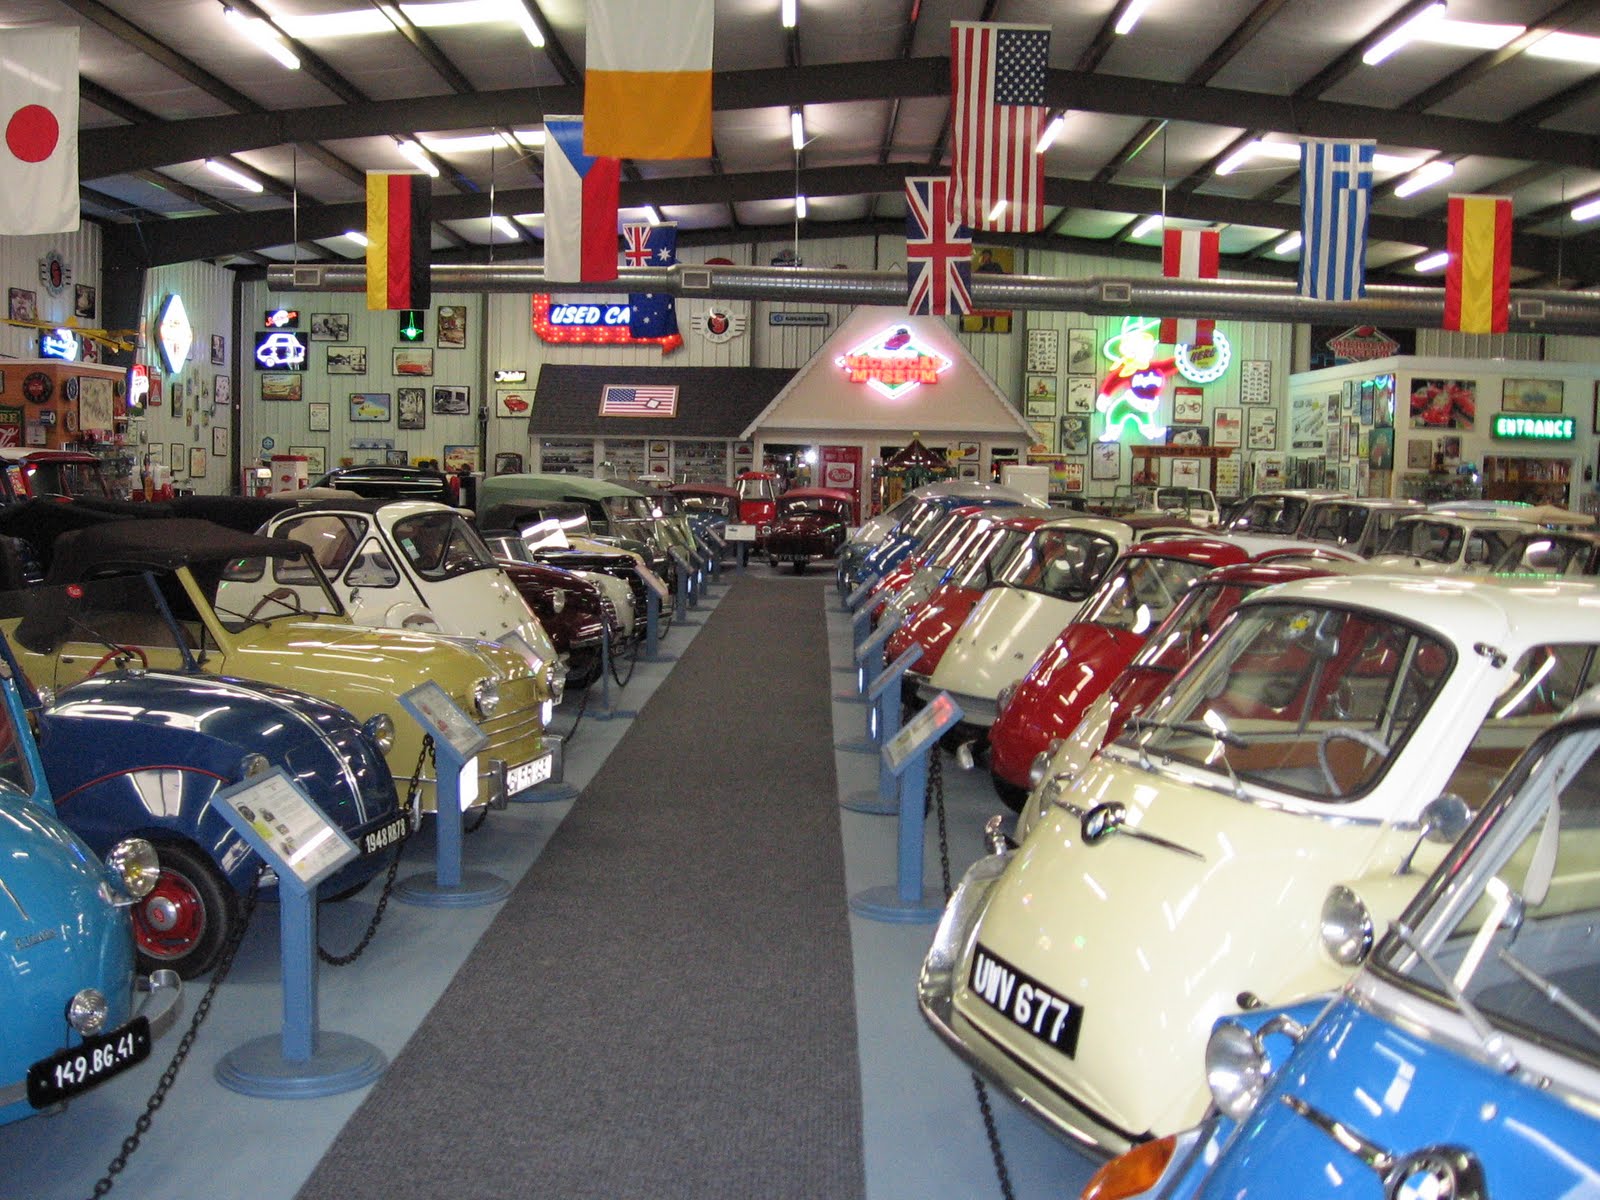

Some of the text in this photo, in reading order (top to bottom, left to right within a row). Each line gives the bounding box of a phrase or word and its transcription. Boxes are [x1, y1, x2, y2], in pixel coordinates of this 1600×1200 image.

[551, 306, 630, 324] USED CA
[851, 369, 936, 382] MUSEUM
[1497, 418, 1573, 438] ENTRANCE
[973, 953, 1070, 1044] UWV 677
